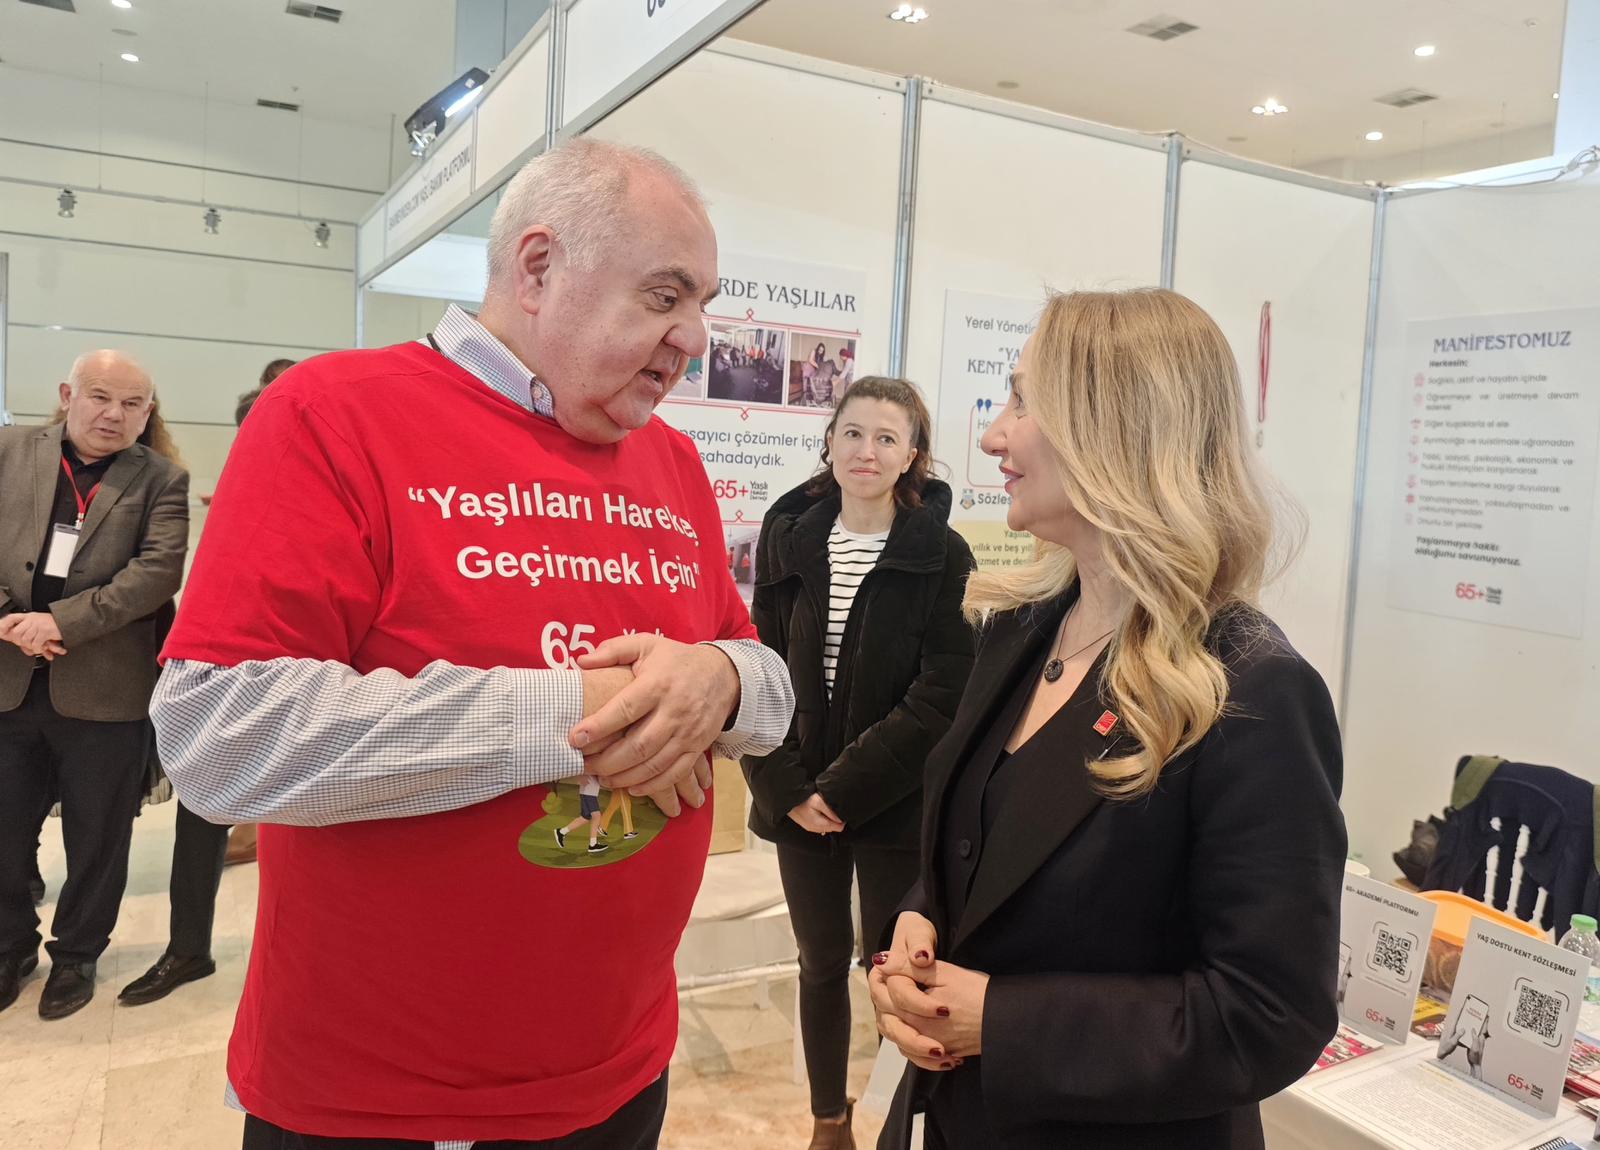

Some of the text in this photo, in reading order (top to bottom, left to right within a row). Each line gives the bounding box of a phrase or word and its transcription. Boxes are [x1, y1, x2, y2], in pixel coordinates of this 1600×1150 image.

[766, 284, 856, 312] YAŞLILAR
[965, 316, 994, 330] Yerel
[1433, 331, 1572, 353] MANİFESTOMUZ
[967, 359, 1004, 375] KENT
[734, 431, 799, 447] çözümler
[699, 450, 785, 469] sahadaydık.
[713, 479, 749, 499] 65+
[408, 482, 593, 526] “Yaşlıları
[456, 544, 643, 587] Geçirmek
[1455, 581, 1484, 600] 65+
[1477, 932, 1577, 976] YAŞ DOSTU KENT SÖZLEŞMESİ
[1365, 1008, 1385, 1024] 65+
[1508, 1073, 1531, 1091] 65+
